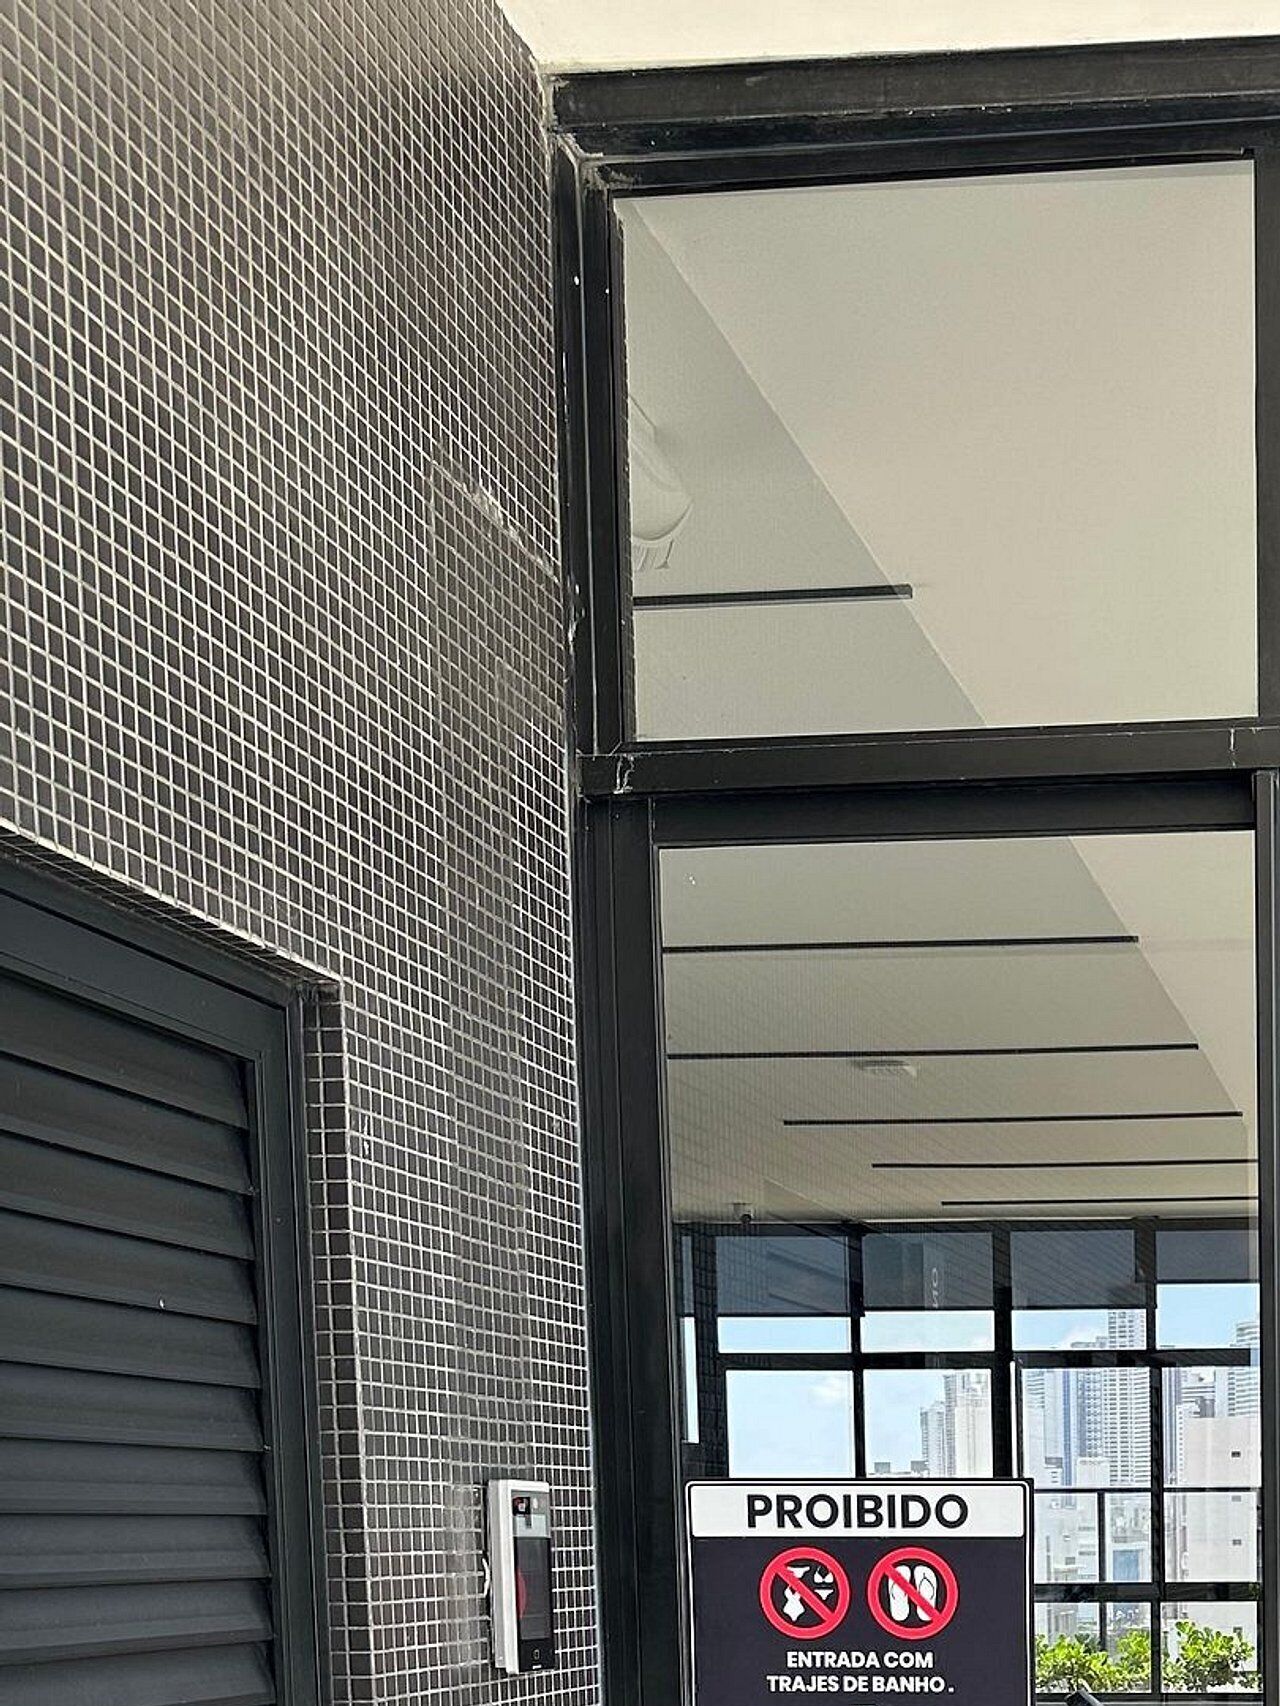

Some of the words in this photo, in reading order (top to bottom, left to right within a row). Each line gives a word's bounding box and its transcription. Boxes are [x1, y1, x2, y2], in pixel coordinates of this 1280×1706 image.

[747, 1494, 969, 1529] PROIBIDO
[786, 1651, 881, 1669] ENTRADA
[883, 1651, 934, 1669] COM
[766, 1675, 840, 1692] TRAJES
[843, 1675, 869, 1692] DE
